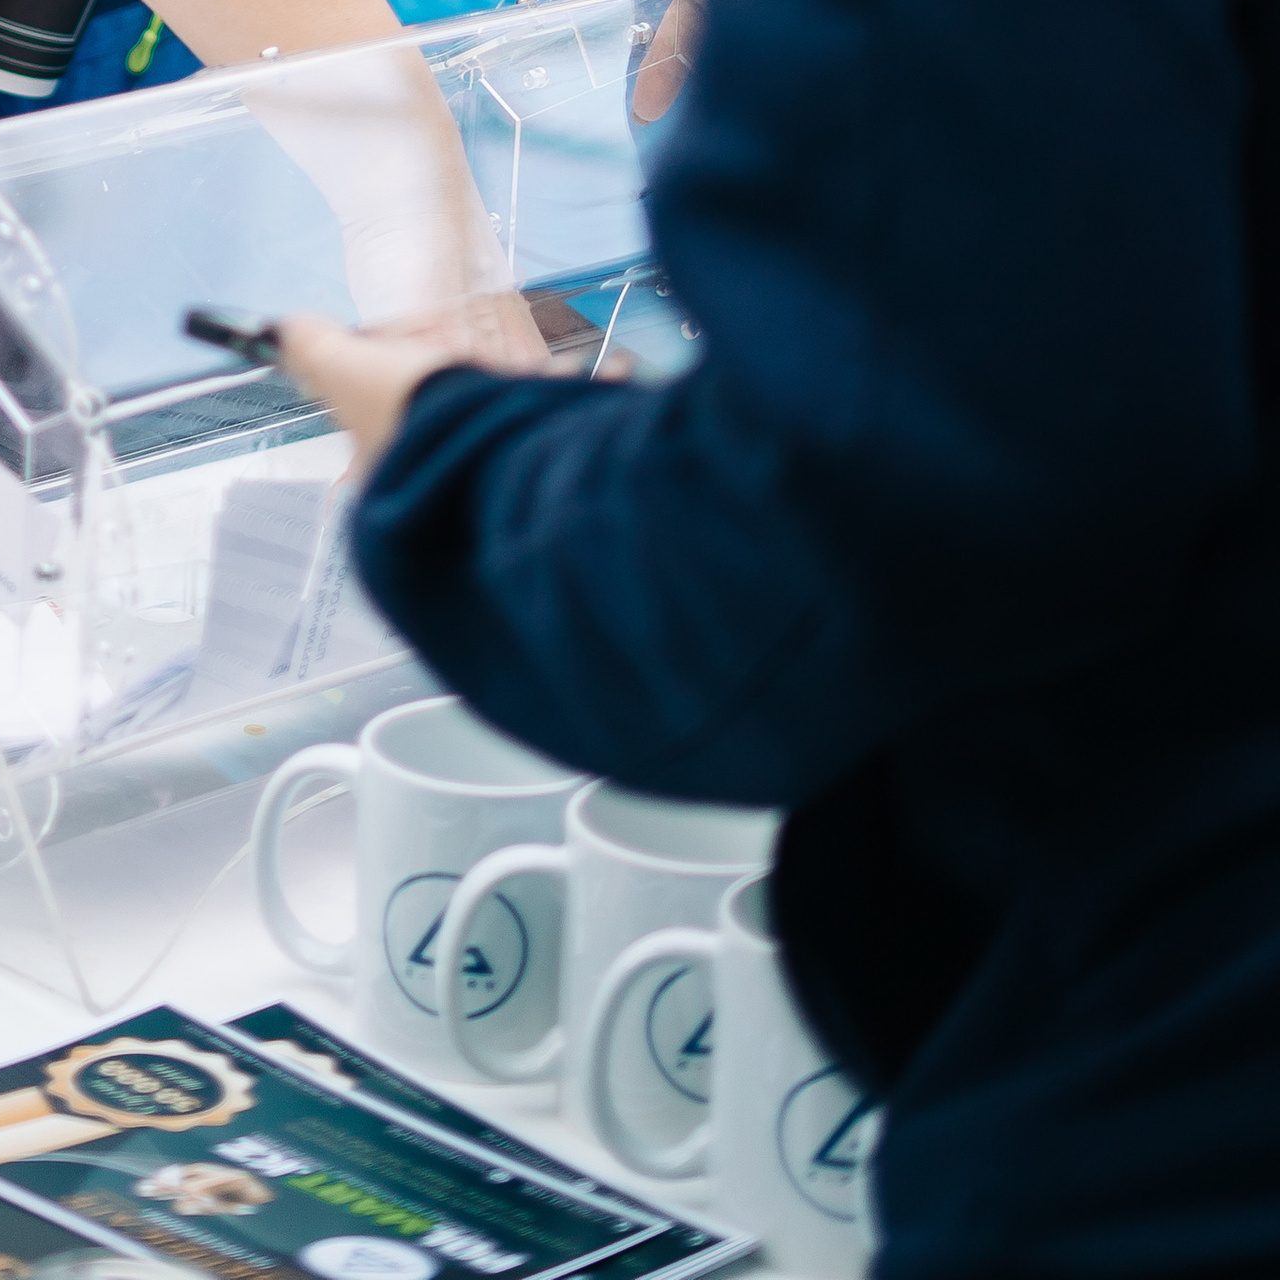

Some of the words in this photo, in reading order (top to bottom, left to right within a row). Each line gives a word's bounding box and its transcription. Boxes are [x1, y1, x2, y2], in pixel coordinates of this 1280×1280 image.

[298, 589, 327, 678] СЕРТИФИКАТ
[316, 622, 332, 662] ШТОР
[330, 566, 349, 605] САЛО
